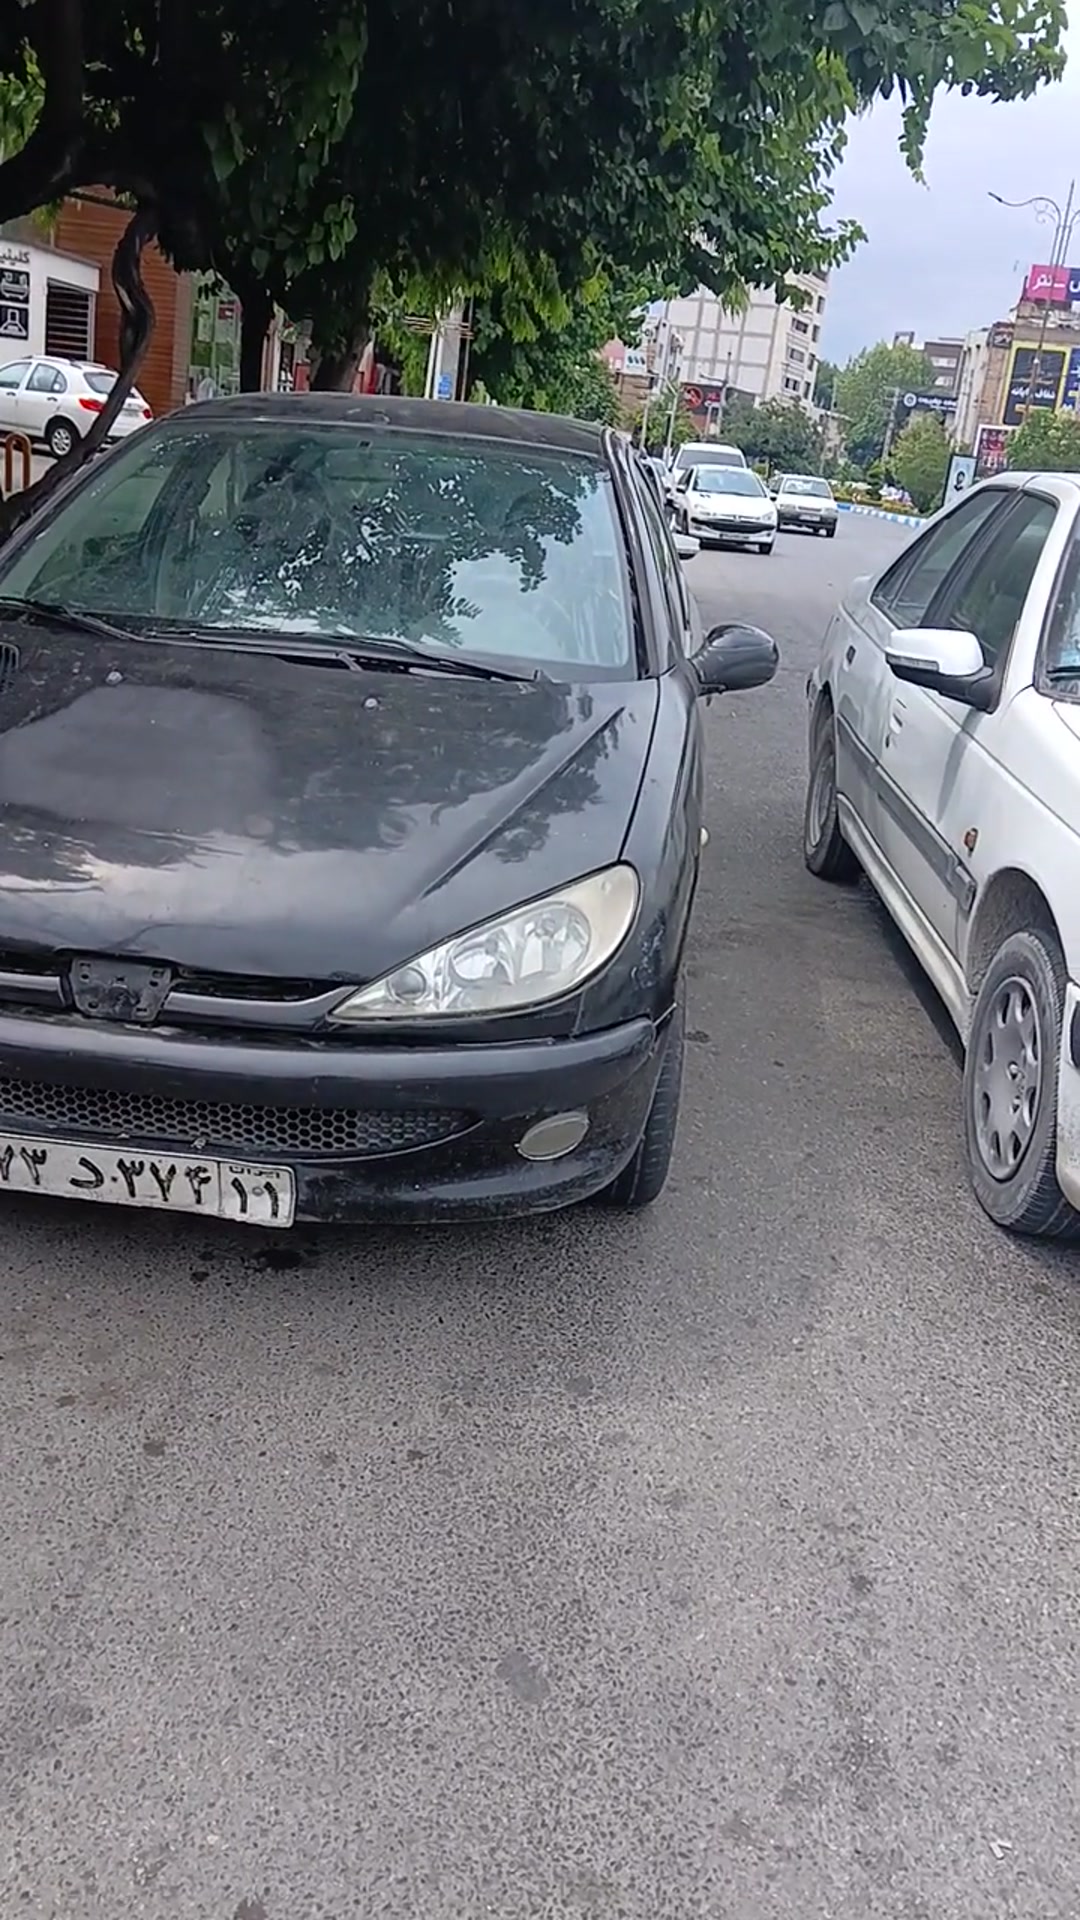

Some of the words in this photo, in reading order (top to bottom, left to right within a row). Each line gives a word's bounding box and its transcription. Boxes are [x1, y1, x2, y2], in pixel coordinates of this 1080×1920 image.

[0, 248, 30, 266] کلینی
[229, 1166, 280, 1179] ایران
[70, 1157, 104, 1188] د
[117, 1158, 211, 1204] ۳۷۴
[231, 1177, 279, 1218] ۱۱
